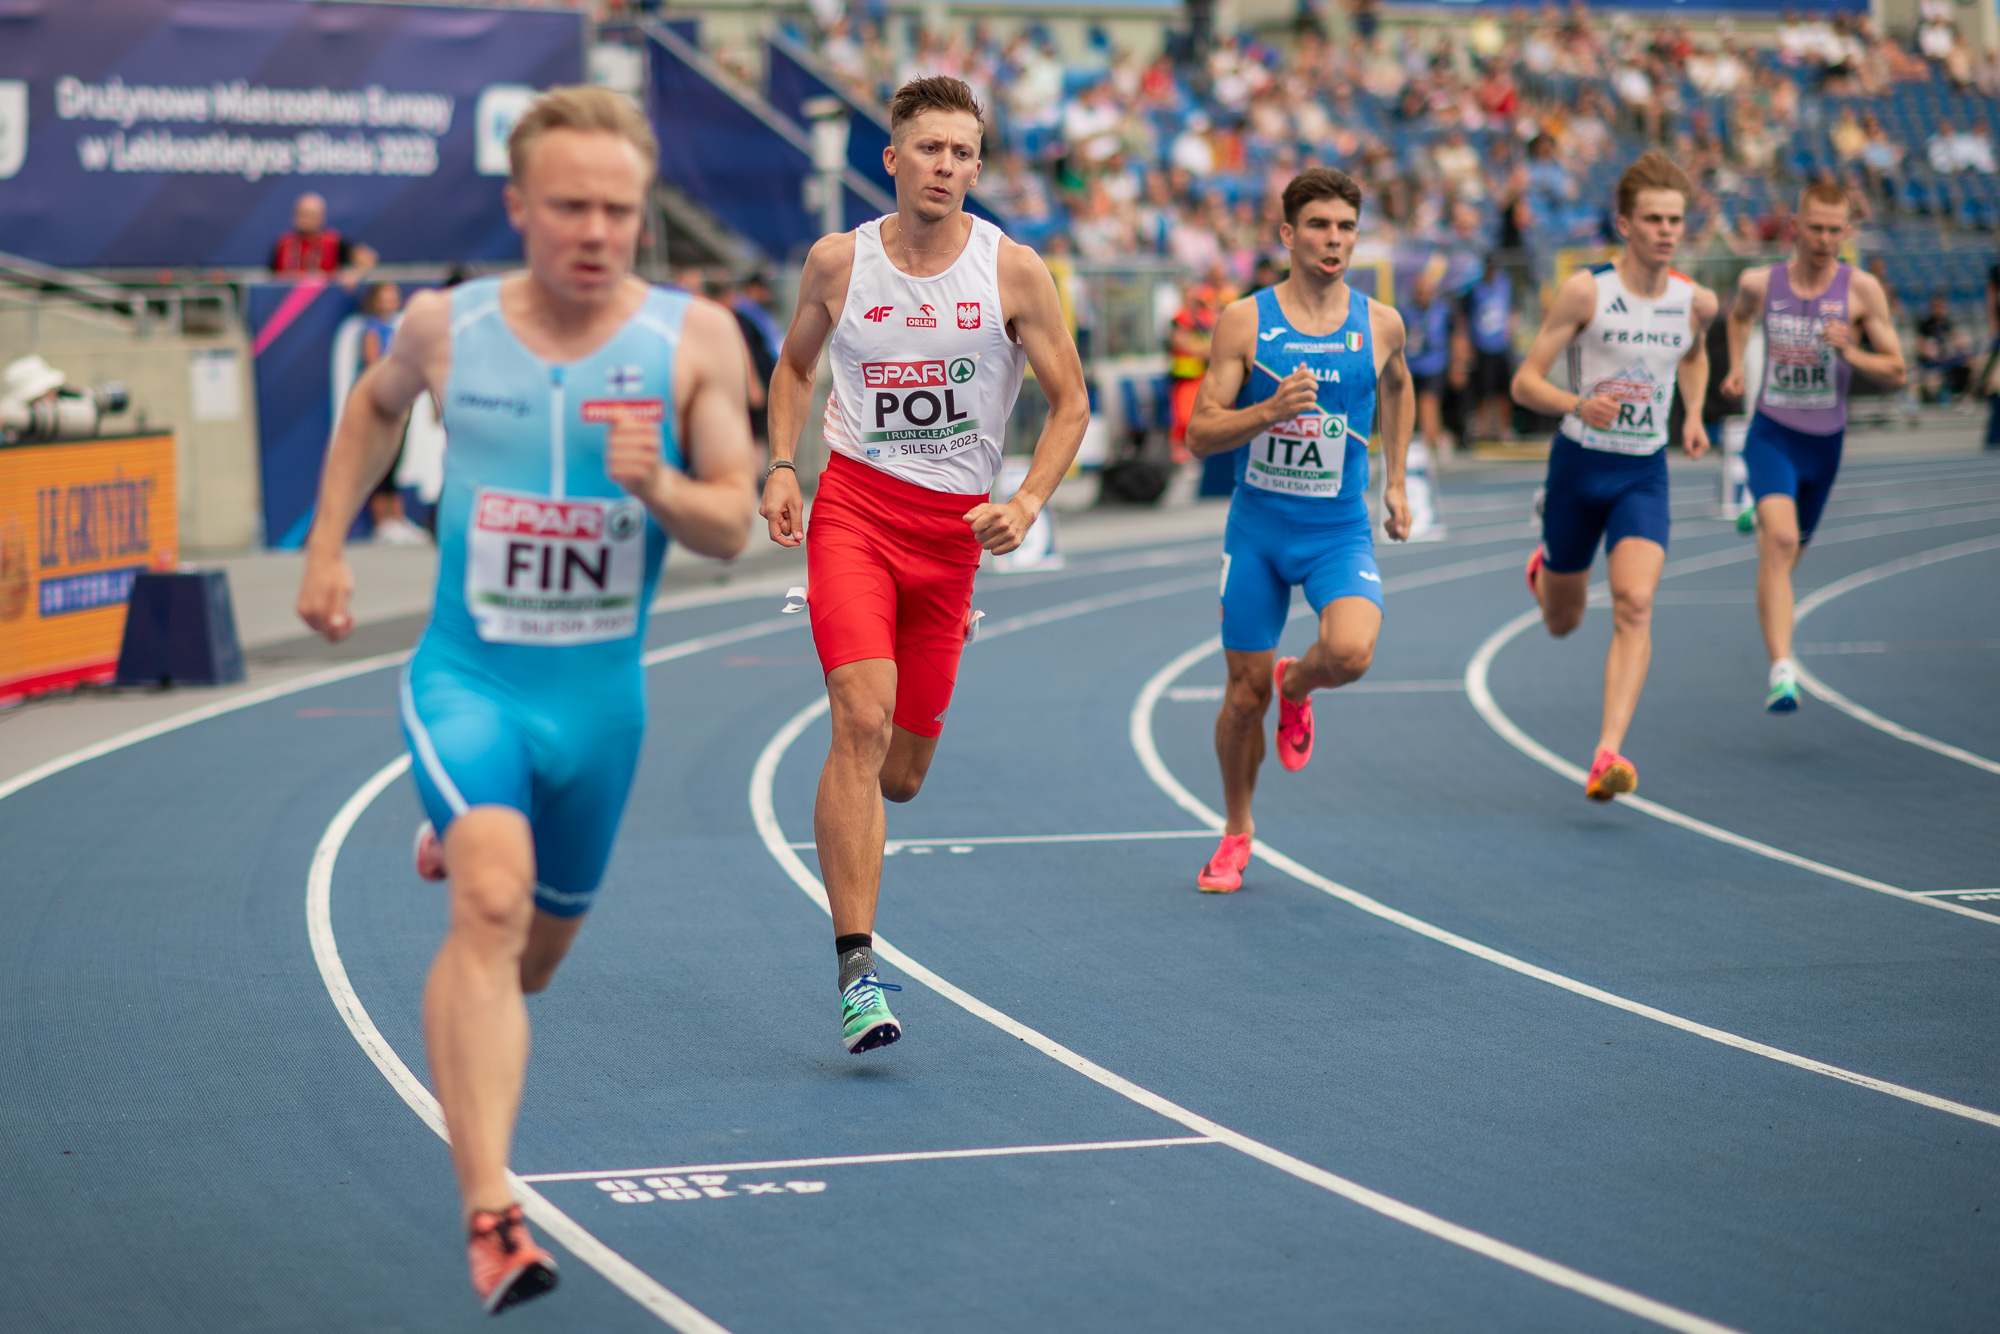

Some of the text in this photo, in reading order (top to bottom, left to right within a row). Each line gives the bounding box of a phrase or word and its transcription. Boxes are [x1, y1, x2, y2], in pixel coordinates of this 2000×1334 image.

[863, 306, 894, 322] 4F
[907, 318, 935, 327] ORLEN
[1767, 314, 1826, 335] GREA
[1603, 330, 1682, 346] FRANCE
[865, 364, 944, 385] SPAR
[1775, 364, 1826, 386] GBR
[876, 389, 968, 428] POL
[1618, 403, 1654, 427] RA
[886, 432, 889, 440] I
[892, 430, 916, 439] RUN
[1269, 419, 1320, 436] PAR
[900, 433, 978, 455] SILESIA 2023
[1267, 436, 1323, 468] ITA
[1267, 467, 1288, 476] RUN
[1272, 478, 1310, 491] SILESIA
[482, 499, 600, 539] SPAR
[507, 541, 612, 592] FIN
